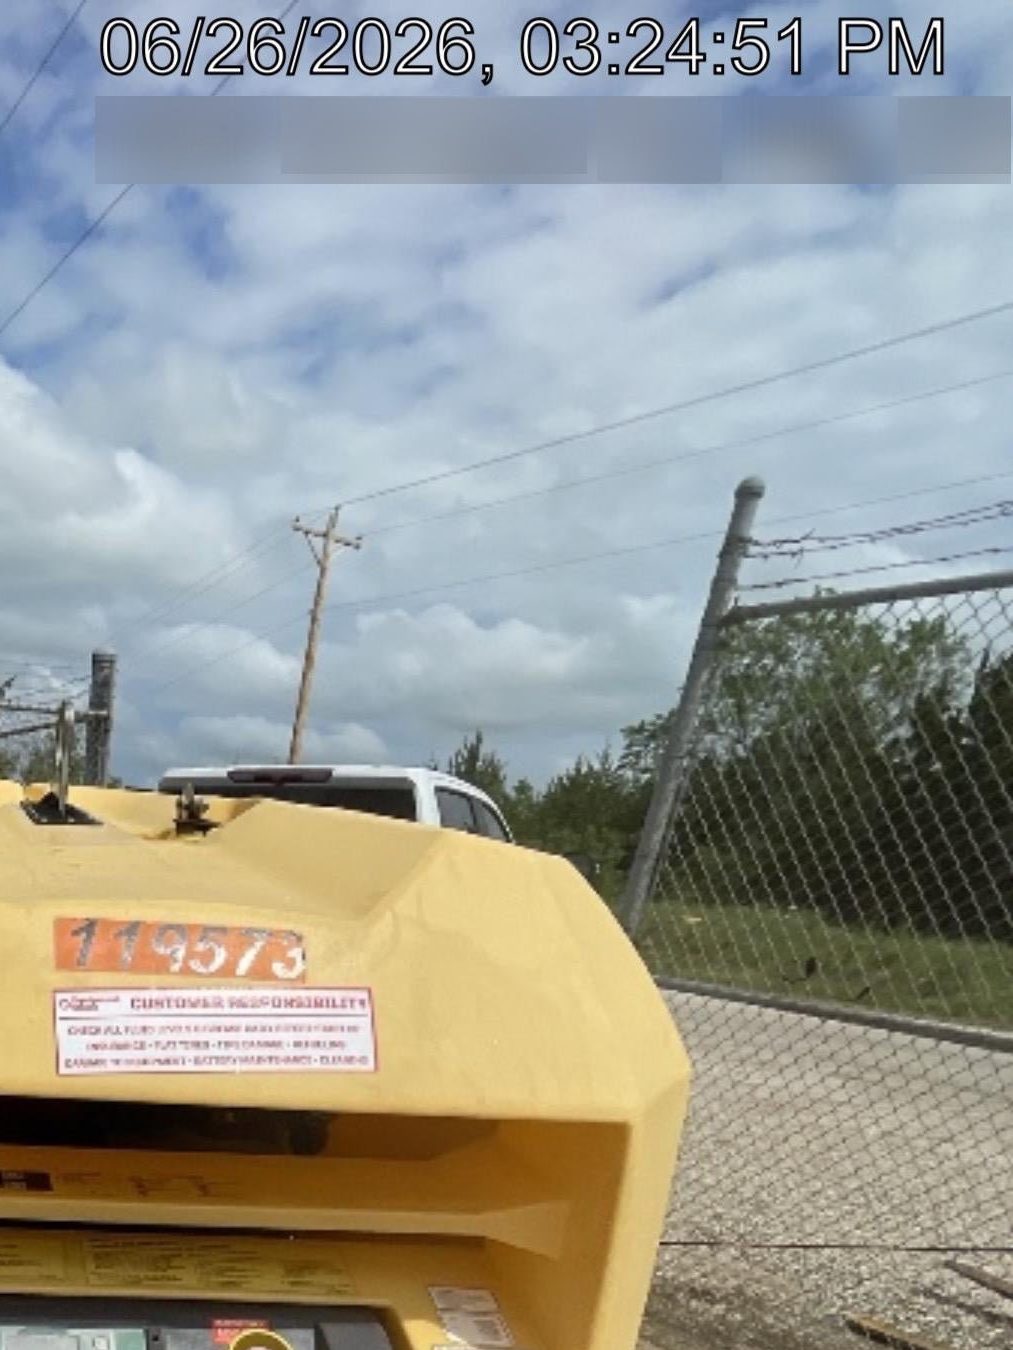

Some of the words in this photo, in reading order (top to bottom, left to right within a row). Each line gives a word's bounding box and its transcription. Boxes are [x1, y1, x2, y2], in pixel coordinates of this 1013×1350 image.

[71, 918, 306, 980] 119573
[130, 997, 225, 1010] CUSTOMER
[229, 996, 367, 1010] RESPONSIBILITY
